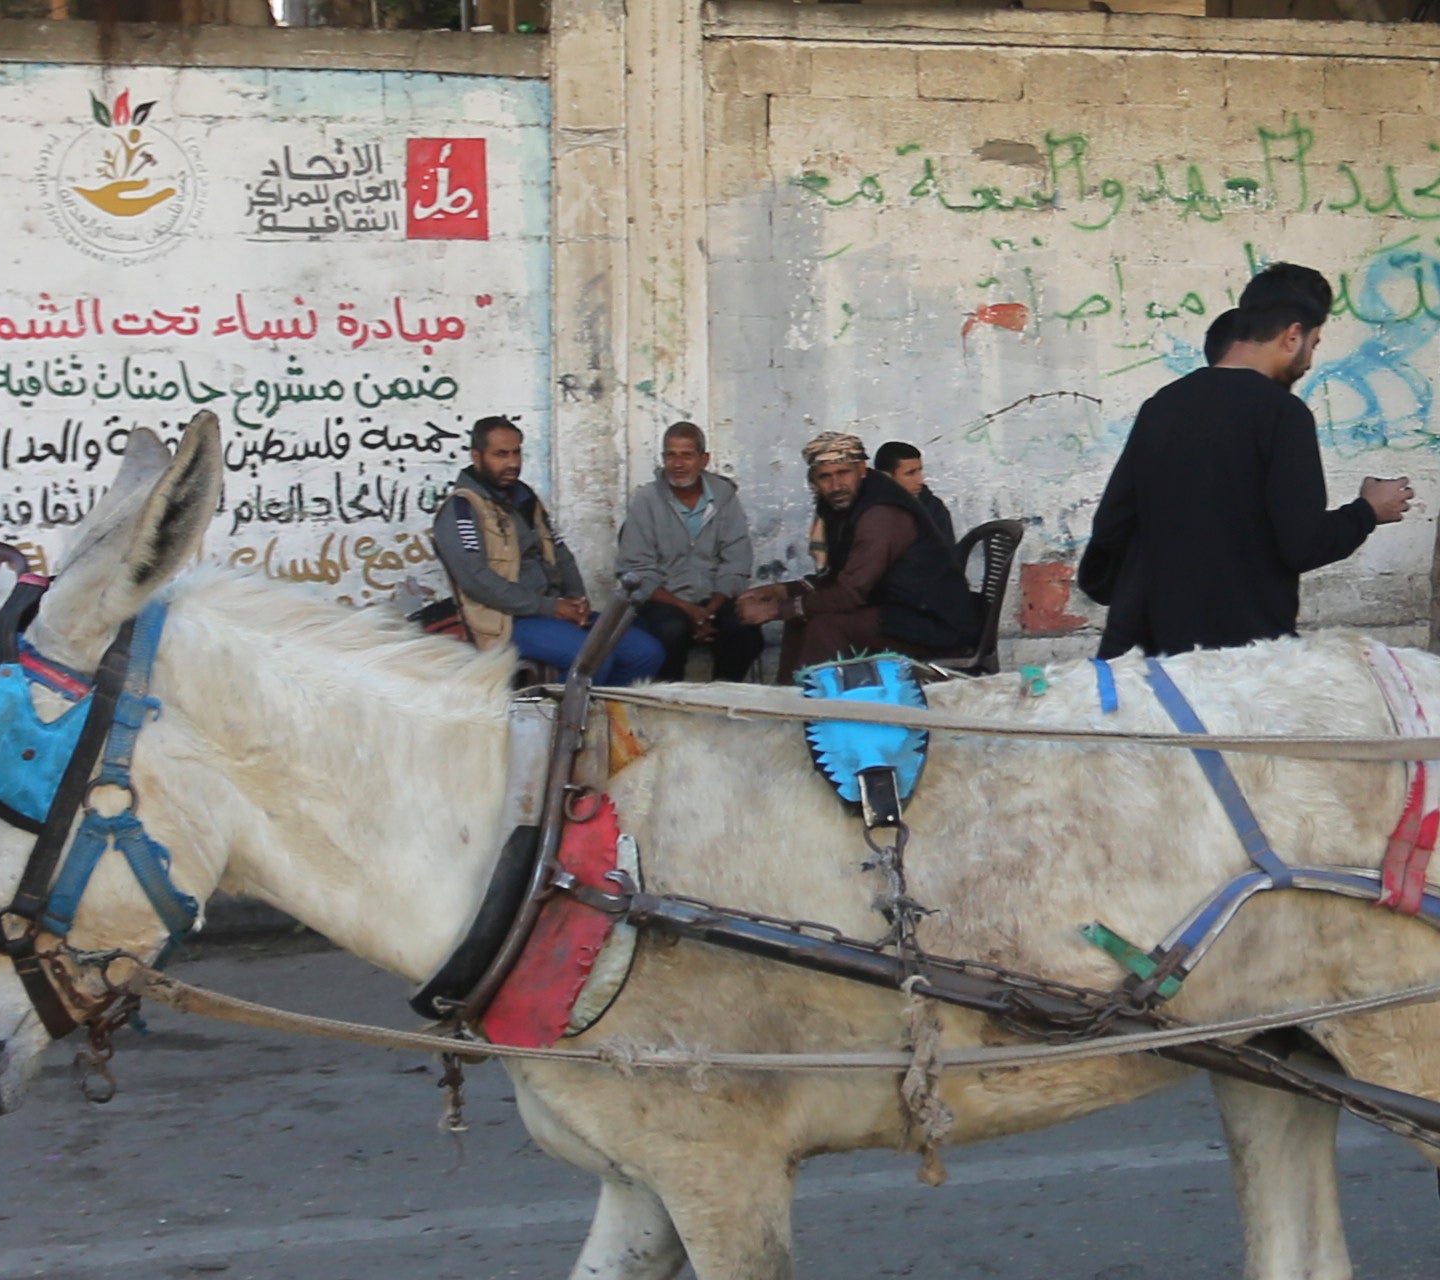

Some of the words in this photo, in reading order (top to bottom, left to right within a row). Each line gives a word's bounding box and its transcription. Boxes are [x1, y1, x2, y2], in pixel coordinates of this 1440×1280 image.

[261, 138, 382, 182] الاتحاد
[258, 206, 399, 242] الثقافية
[111, 305, 201, 337] تحت
[212, 293, 318, 341] نساء
[336, 296, 466, 355] مبادرة
[232, 355, 346, 430] مشروع
[353, 364, 460, 409] ضمن
[224, 416, 351, 477] فلسطين
[359, 413, 461, 472] جمعية
